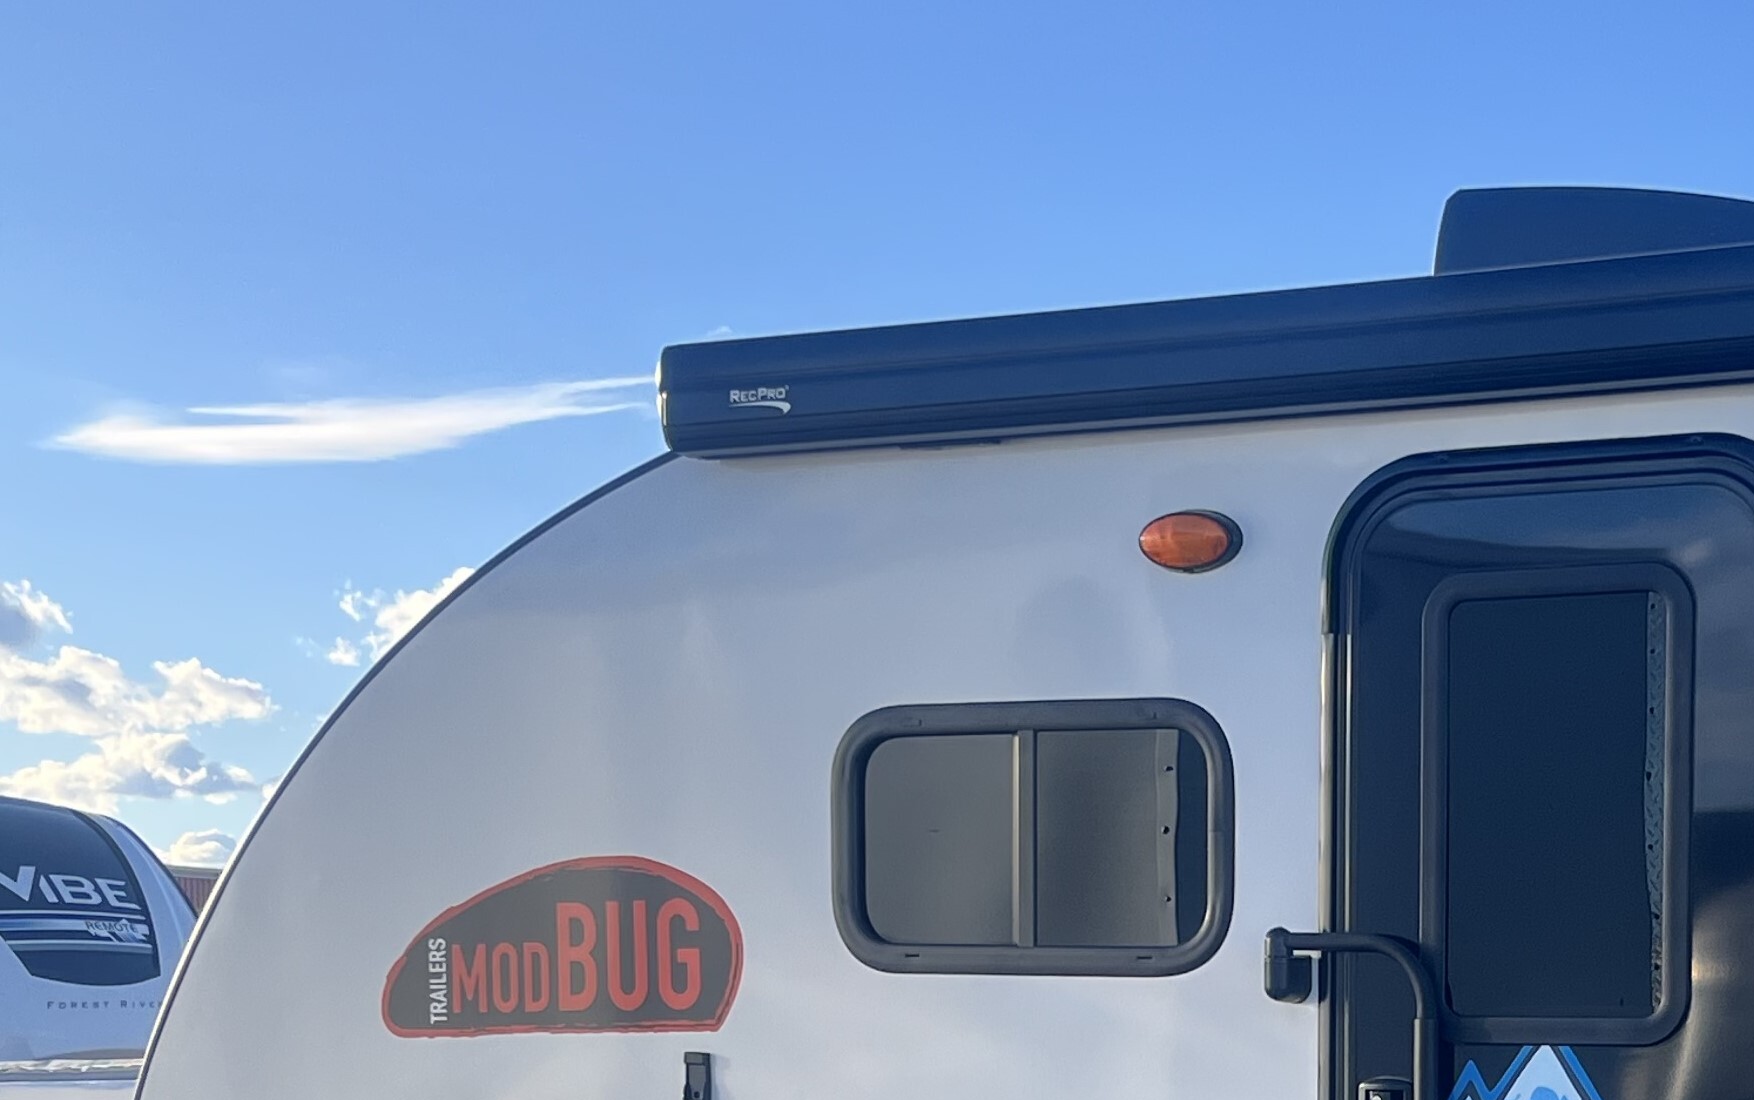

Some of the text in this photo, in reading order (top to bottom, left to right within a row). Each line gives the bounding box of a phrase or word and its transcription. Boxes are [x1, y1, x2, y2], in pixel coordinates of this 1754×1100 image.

[0, 865, 142, 911] VIBE
[84, 919, 138, 933] REMOTE
[427, 936, 448, 1025] TRAILERS
[120, 999, 163, 1009] RIVE
